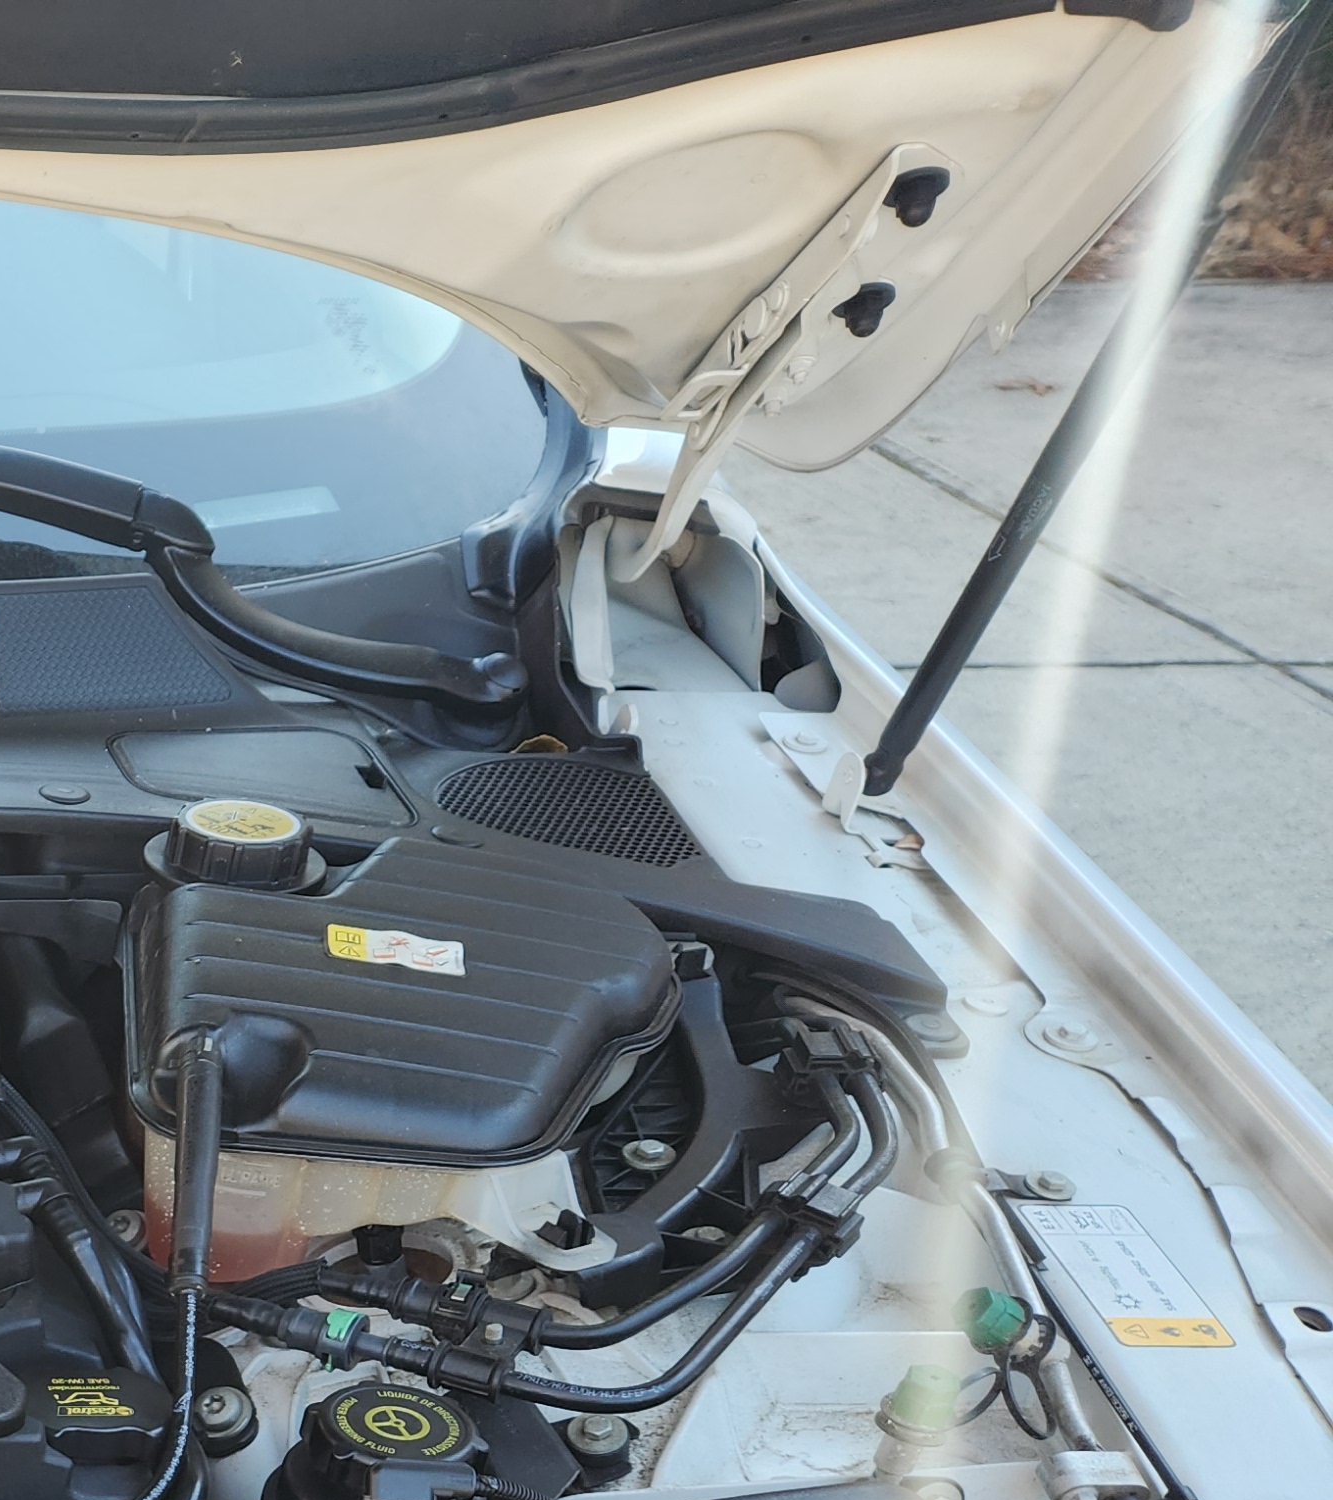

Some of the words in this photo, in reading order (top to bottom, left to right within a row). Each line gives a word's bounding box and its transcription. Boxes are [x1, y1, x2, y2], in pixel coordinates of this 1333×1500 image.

[66, 1407, 116, 1415] Castrol
[337, 1397, 358, 1415] POWER
[377, 1391, 419, 1402] LIQUIDE
[419, 1398, 435, 1408] DE
[433, 1405, 460, 1437] DIRECTION
[336, 1415, 366, 1444] STEERING
[365, 1441, 396, 1454] FLUID
